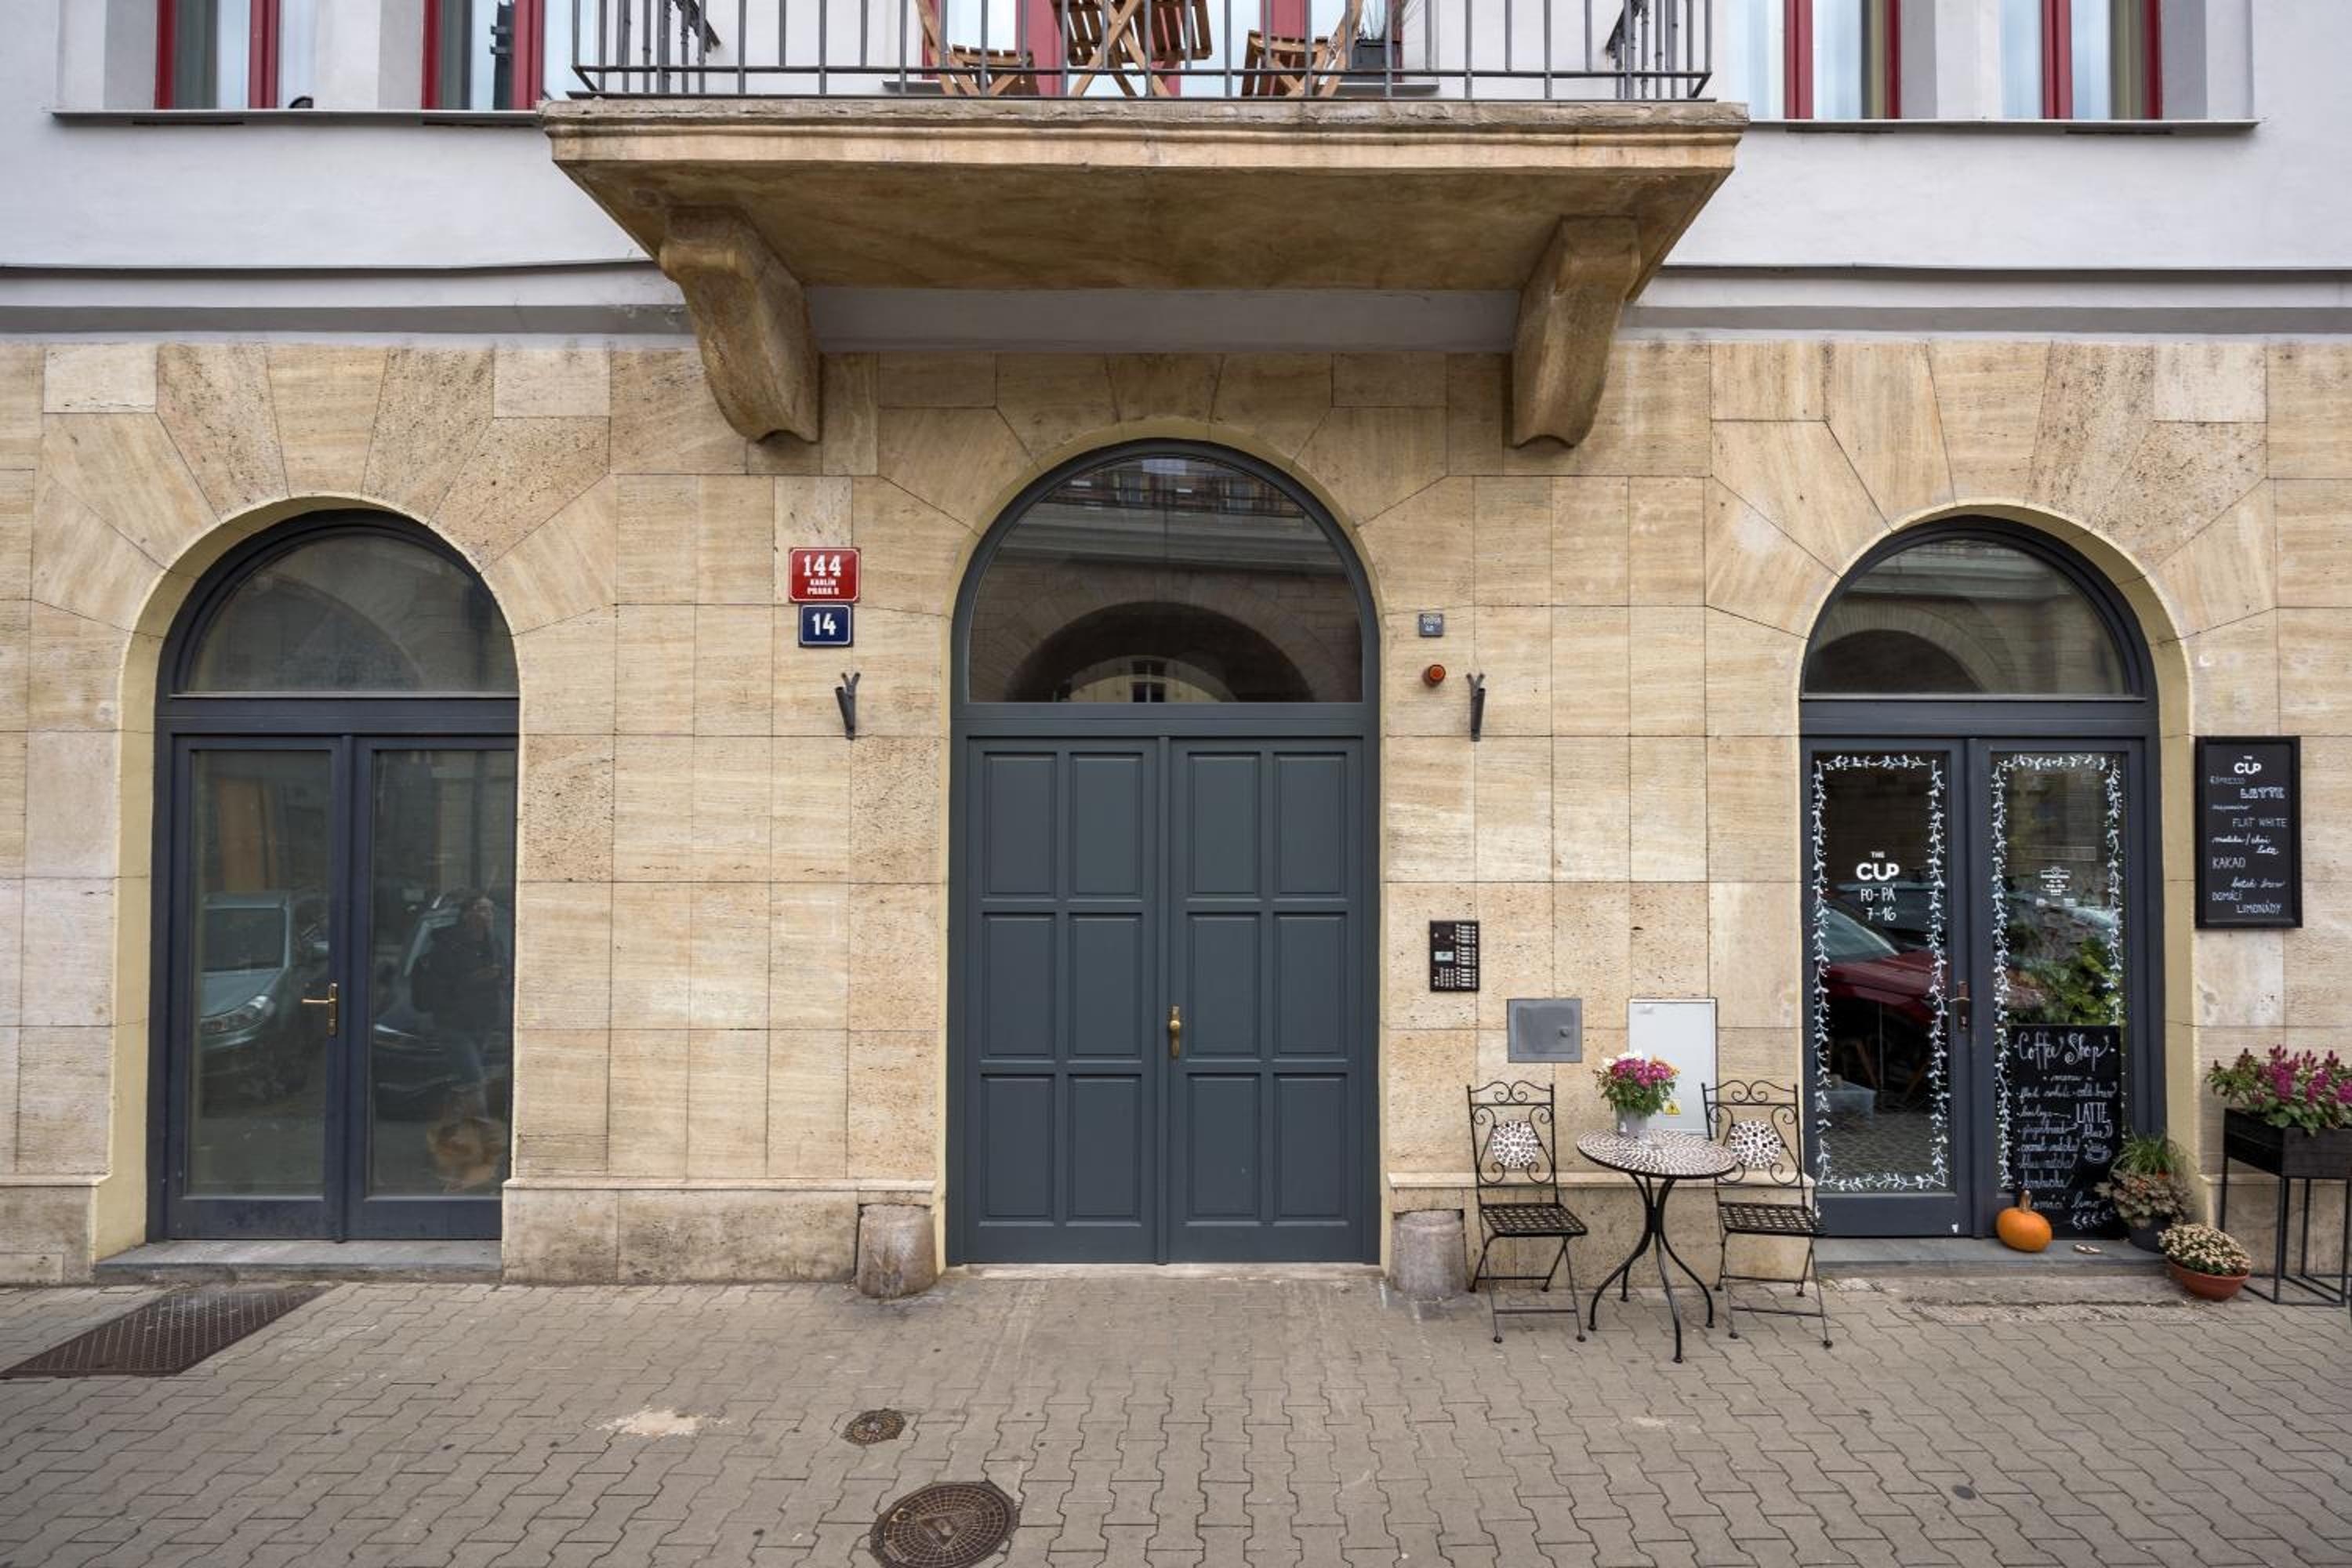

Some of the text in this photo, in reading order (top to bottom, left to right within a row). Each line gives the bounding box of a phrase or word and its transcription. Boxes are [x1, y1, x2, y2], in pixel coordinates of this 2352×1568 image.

[803, 554, 841, 577] 144
[812, 612, 837, 636] 14
[2234, 762, 2262, 775] CUP
[2240, 786, 2285, 799] LATTE
[2232, 818, 2288, 828] FLAT WHITE
[2212, 856, 2246, 869] KAKAO
[1856, 862, 1900, 881] CUP
[2212, 890, 2242, 901] DOMÁCÍ
[2235, 898, 2282, 914] LIMONÁDY
[2019, 1031, 2109, 1072] Coffee Shop
[2076, 1102, 2111, 1123] LATTE
[2032, 1193, 2063, 1208] omácí
